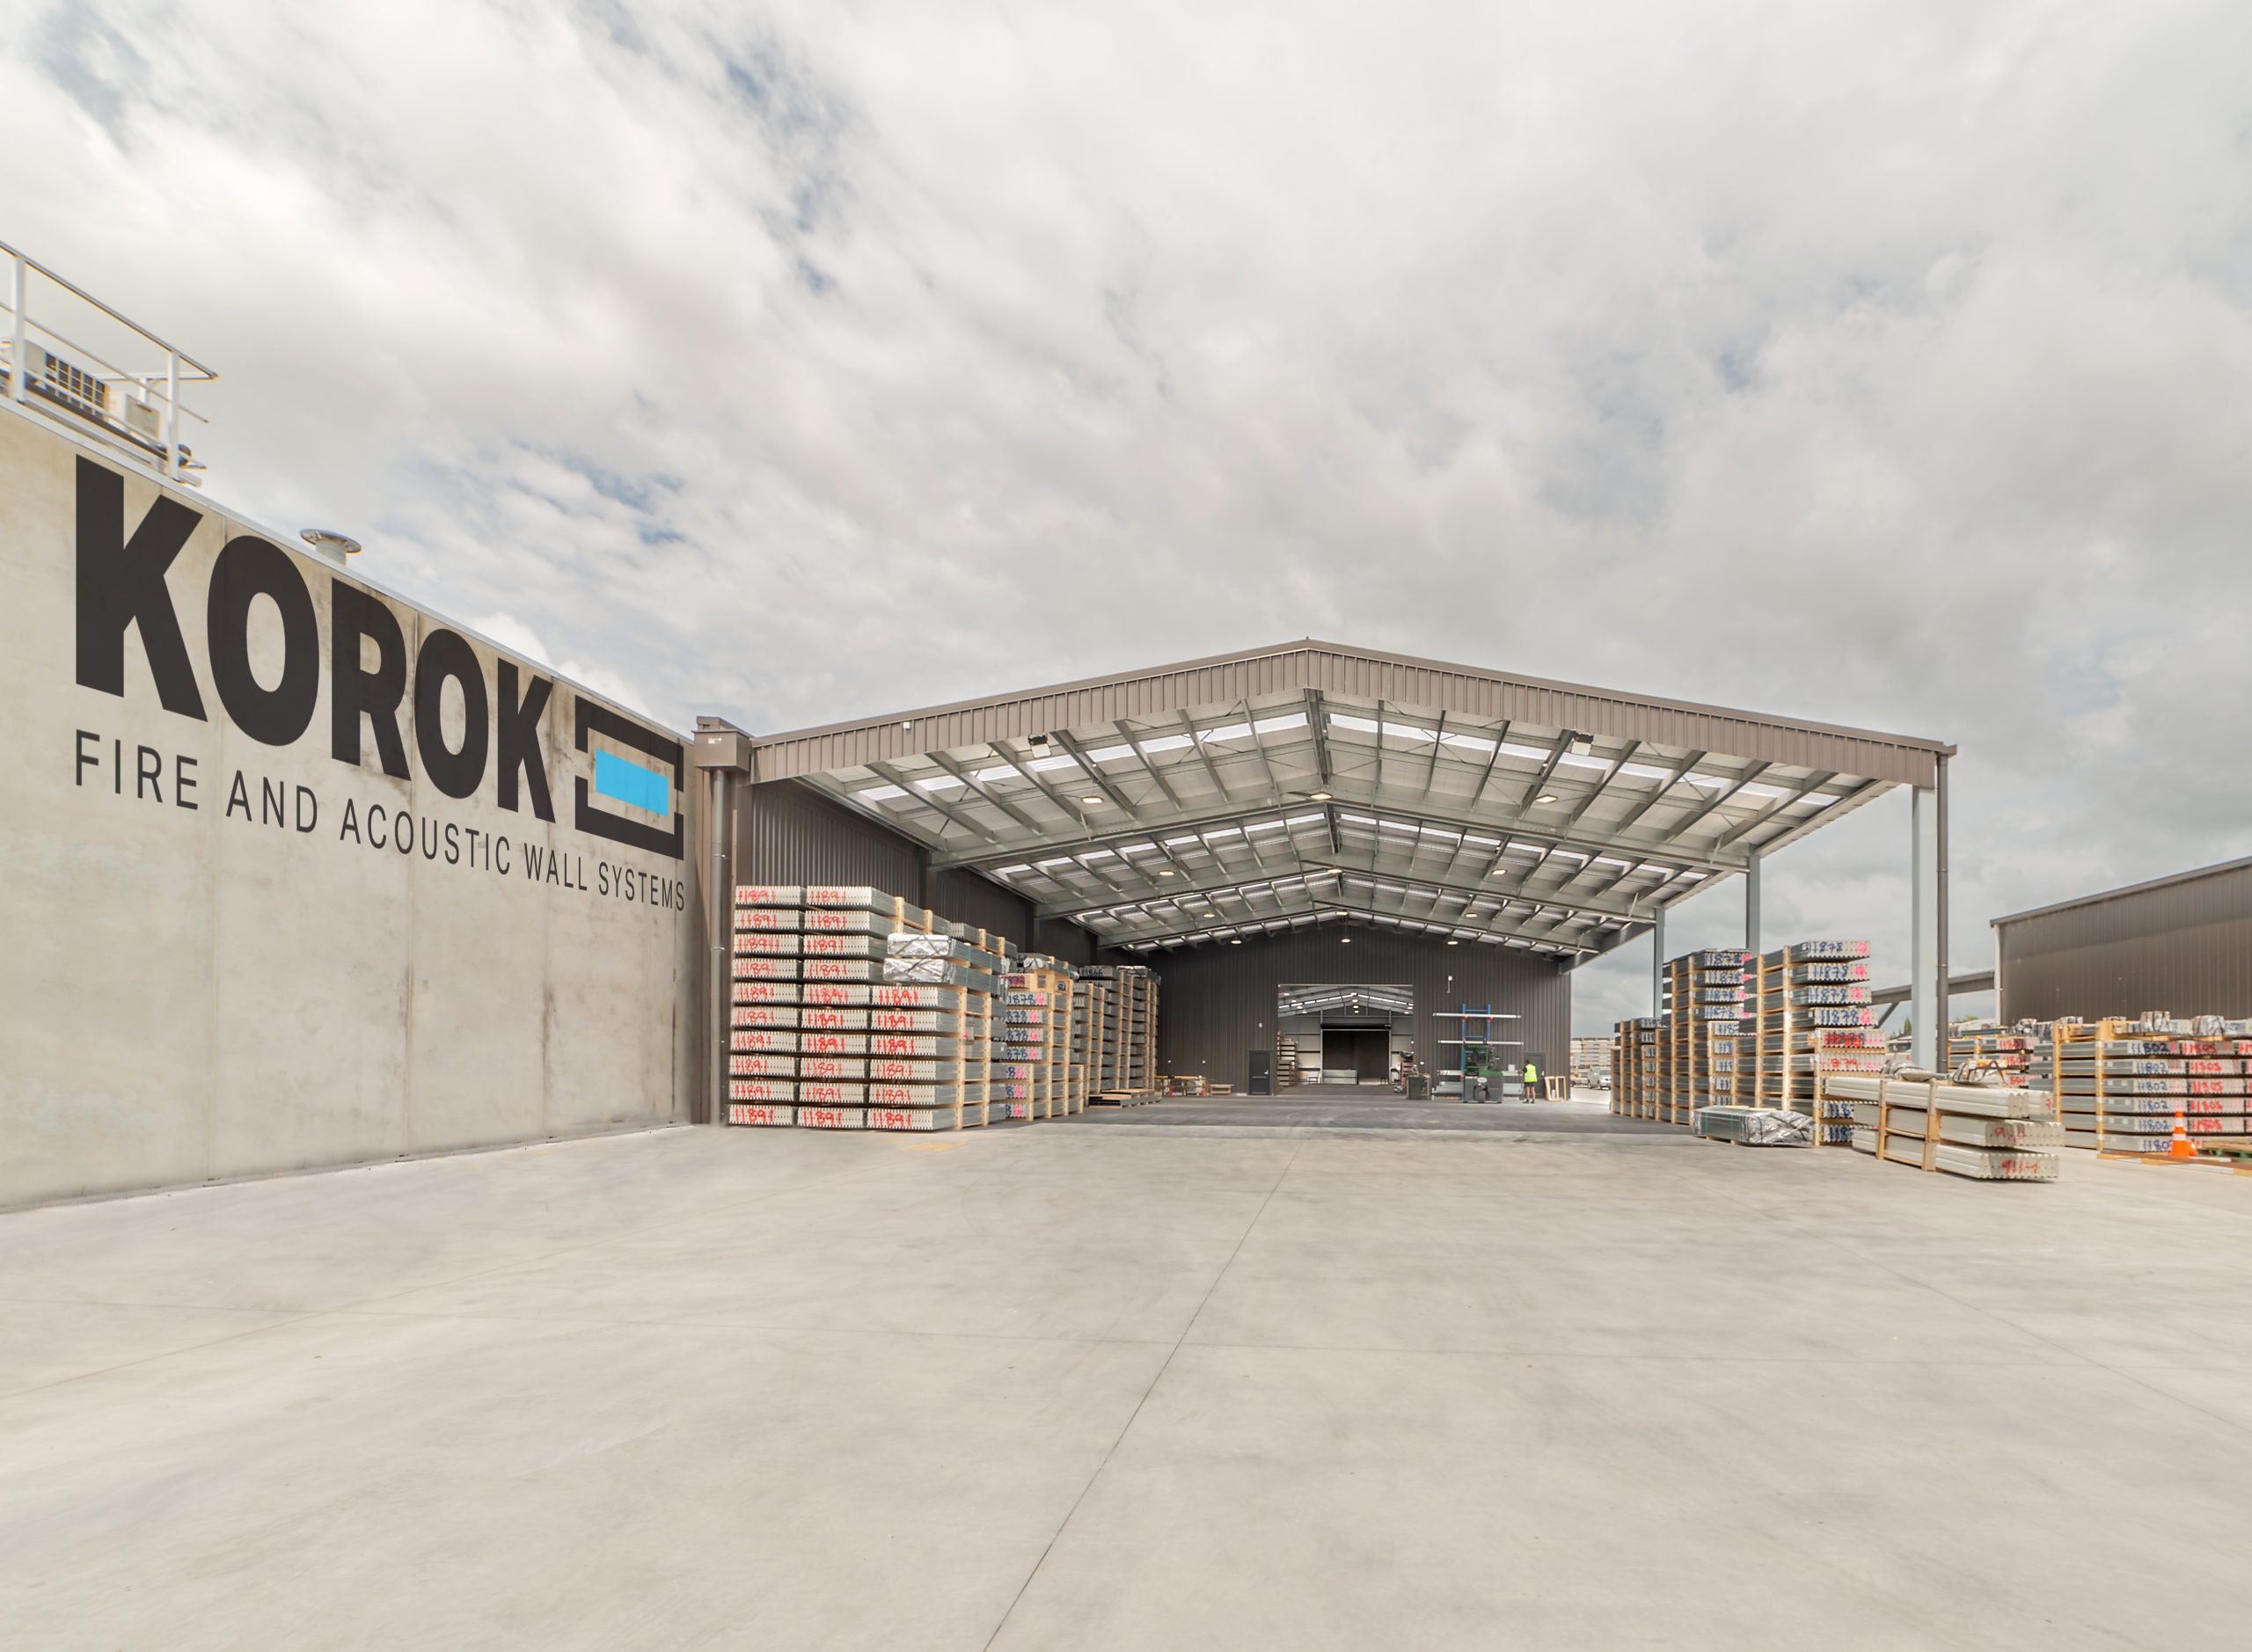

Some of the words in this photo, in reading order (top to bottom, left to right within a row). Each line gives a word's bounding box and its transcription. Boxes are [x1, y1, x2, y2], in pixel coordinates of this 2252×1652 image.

[76, 454, 555, 823] KOROK
[76, 729, 199, 810] FIRE
[226, 770, 318, 832] AND
[340, 798, 510, 875] ACOUSTIC
[524, 842, 588, 891] WALL
[598, 864, 685, 911] SYSTEMS
[810, 890, 846, 903] 11891
[741, 914, 777, 929] 11891
[810, 915, 846, 928] 11891
[807, 939, 844, 952] 11891
[809, 964, 847, 978] 11891
[740, 985, 774, 1000] 11891
[880, 989, 918, 1005] 11891
[736, 1011, 774, 1025] 11891
[808, 1013, 844, 1027] 11891
[877, 1015, 913, 1029] 11891
[736, 1034, 771, 1049] 11891
[807, 1037, 845, 1052] 11891
[877, 1039, 915, 1054] 11891
[735, 1059, 768, 1073] 11891
[807, 1062, 842, 1077] 11891
[876, 1064, 912, 1078] 11891
[735, 1085, 771, 1098] 11891
[806, 1087, 842, 1100] 11891
[875, 1089, 911, 1101] 11891
[735, 1108, 774, 1124] 11891
[803, 1111, 842, 1126] 11891
[873, 1112, 911, 1127] 11891
